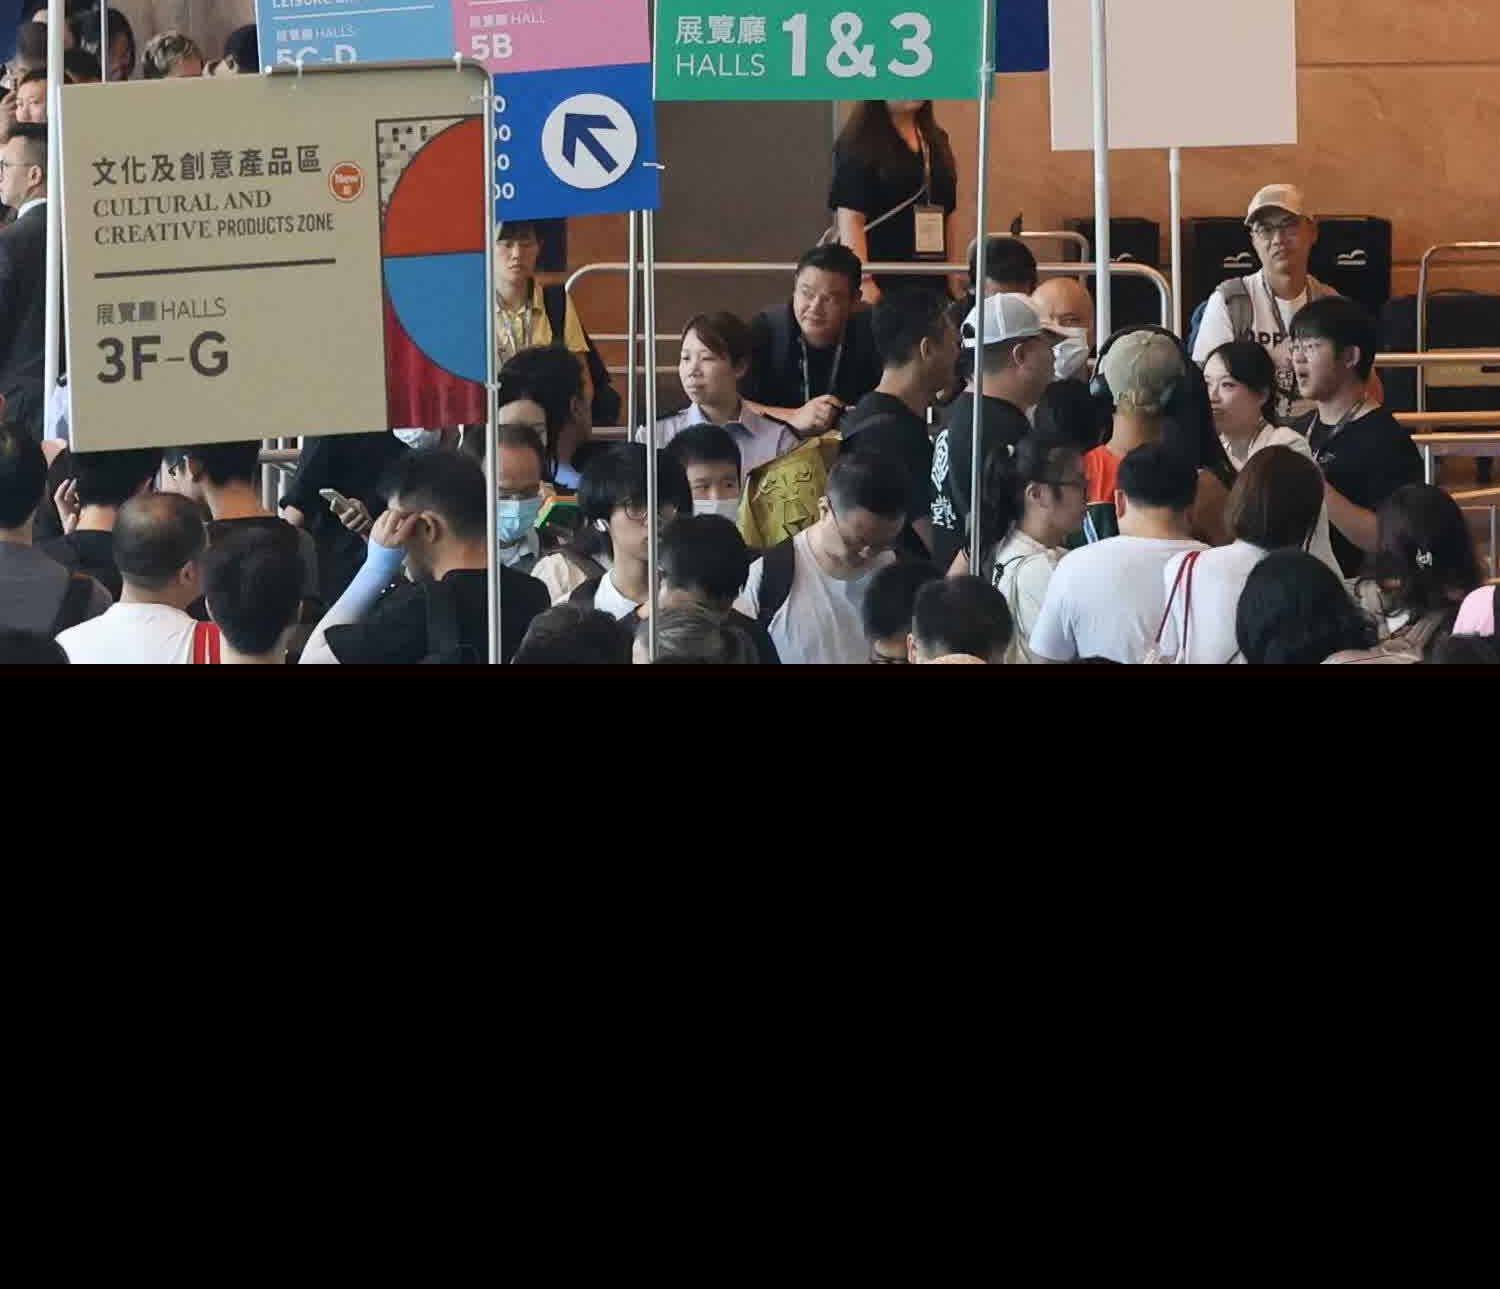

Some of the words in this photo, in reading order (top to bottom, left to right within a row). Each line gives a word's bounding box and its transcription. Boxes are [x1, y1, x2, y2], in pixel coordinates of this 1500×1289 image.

[674, 14, 768, 46] 展覽廳
[470, 33, 514, 61] 5B
[675, 52, 766, 77] HALLS
[92, 144, 322, 187] 文化及創意產品區
[93, 192, 218, 218] CULTURAL
[223, 189, 272, 210] AND
[94, 220, 212, 246] CREATIVE
[217, 215, 294, 238] PRODUCTS
[297, 212, 335, 233] ZONE
[159, 296, 229, 321] HALLS
[96, 330, 230, 384] 3F-G
